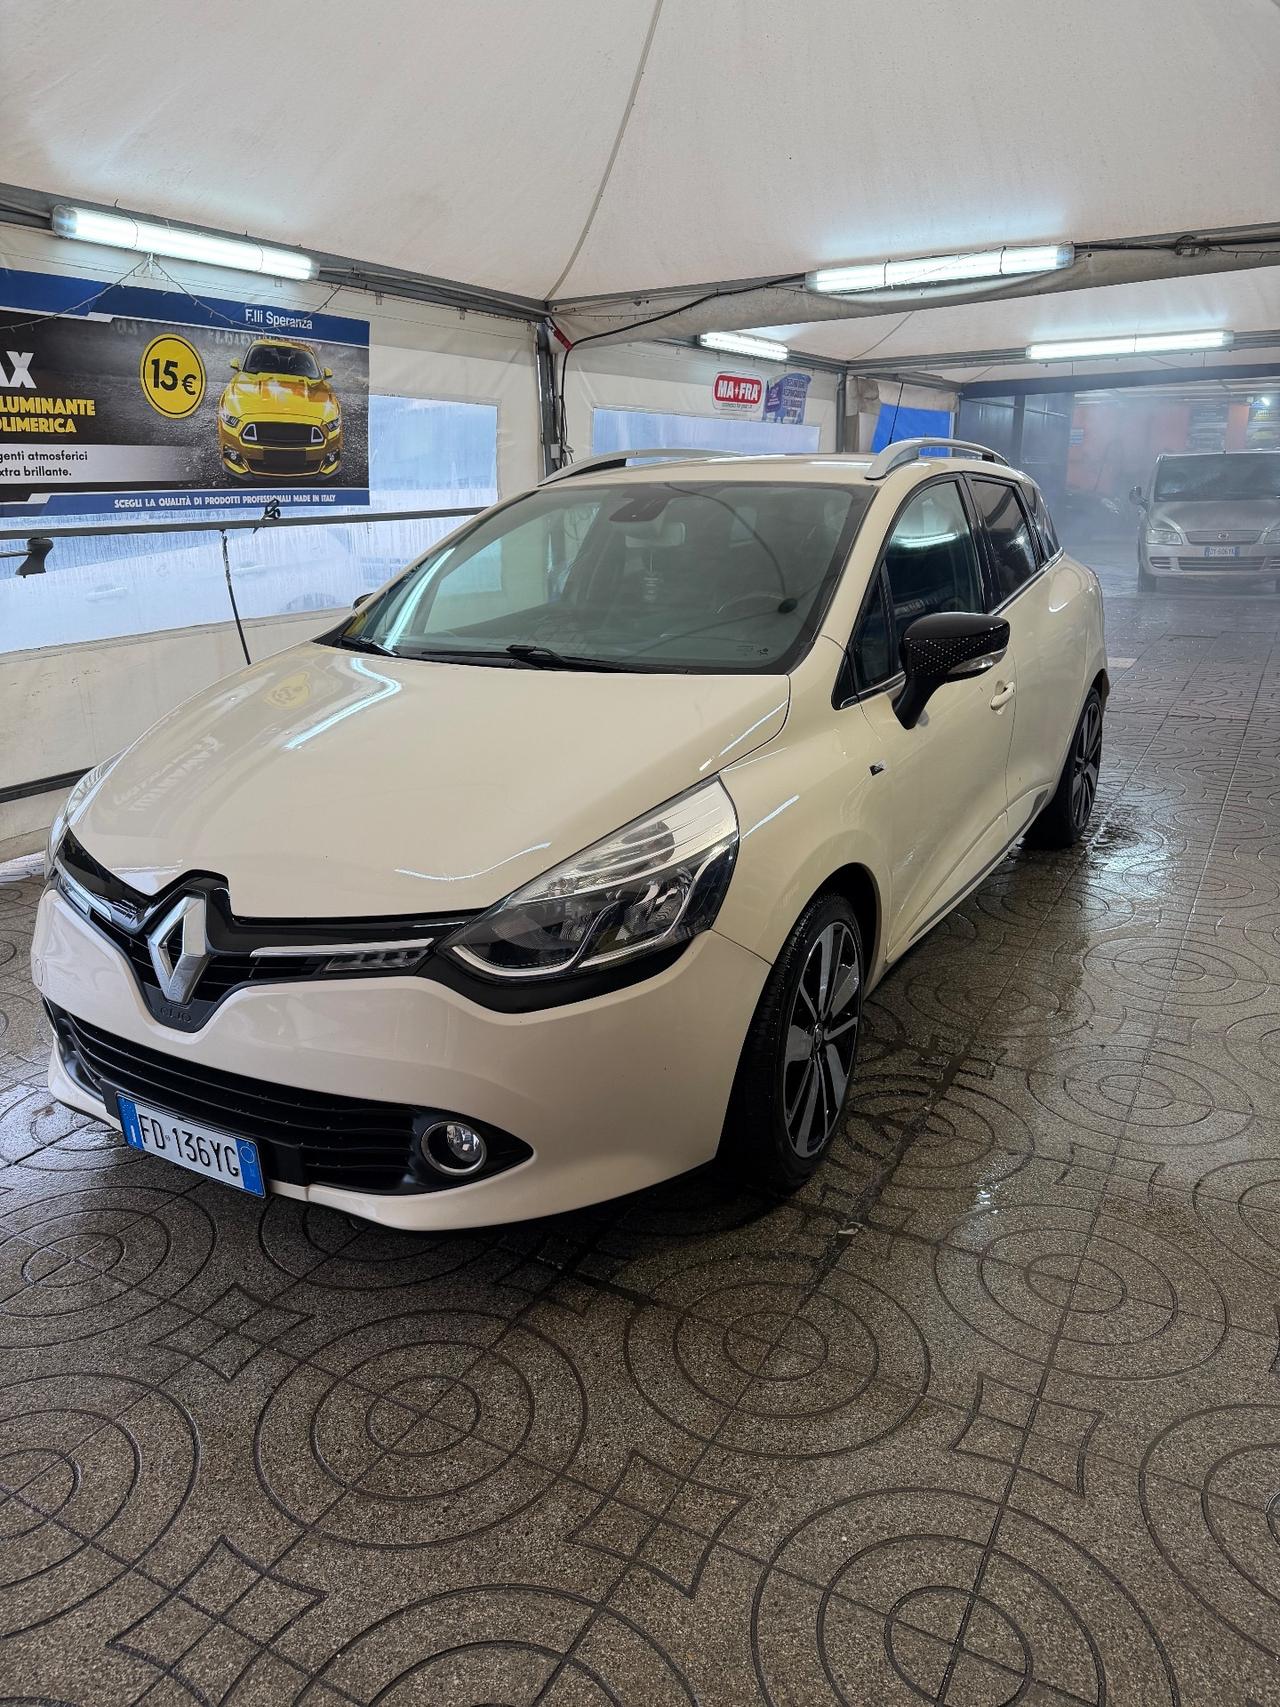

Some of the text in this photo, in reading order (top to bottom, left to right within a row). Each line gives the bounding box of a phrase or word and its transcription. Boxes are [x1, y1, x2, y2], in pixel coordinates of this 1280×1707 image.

[266, 311, 313, 330] Speranza
[0, 416, 77, 433] LIMERICA
[28, 450, 88, 461] atmosferici
[24, 465, 72, 477] brillante.
[114, 499, 142, 508] SCEGLI
[145, 498, 156, 507] LA
[159, 495, 191, 507] QUALITÀ
[194, 497, 202, 505] DI
[205, 496, 240, 505] PRODOTTI
[293, 494, 311, 502] MADE
[312, 494, 320, 502] IN
[321, 494, 336, 503] ITALY
